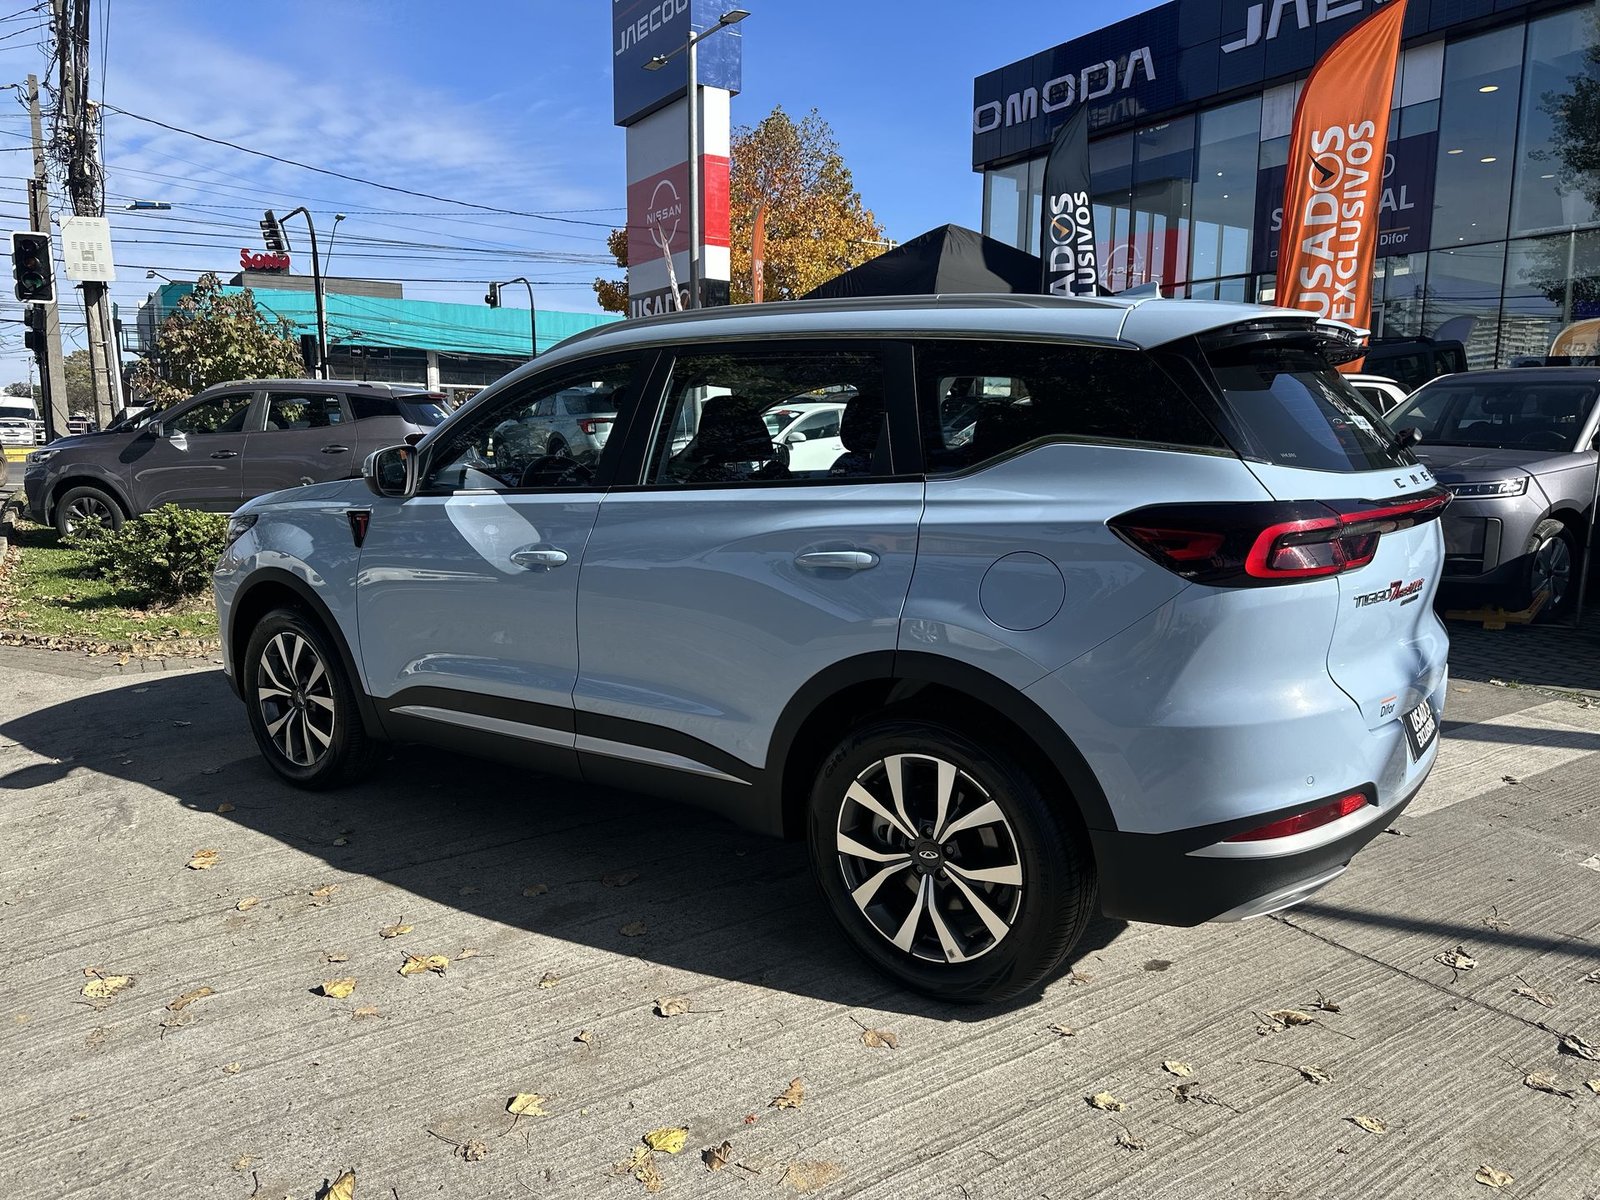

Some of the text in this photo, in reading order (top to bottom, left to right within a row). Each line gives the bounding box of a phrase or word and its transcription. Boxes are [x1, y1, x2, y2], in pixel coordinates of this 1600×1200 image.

[974, 46, 1156, 135] OMODA
[646, 203, 682, 225] NISSAN
[1050, 192, 1076, 297] ADOS
[1073, 190, 1097, 297] LUSIVOS
[1331, 120, 1375, 320] EXCLUSIVOS
[1379, 232, 1409, 247] Difor
